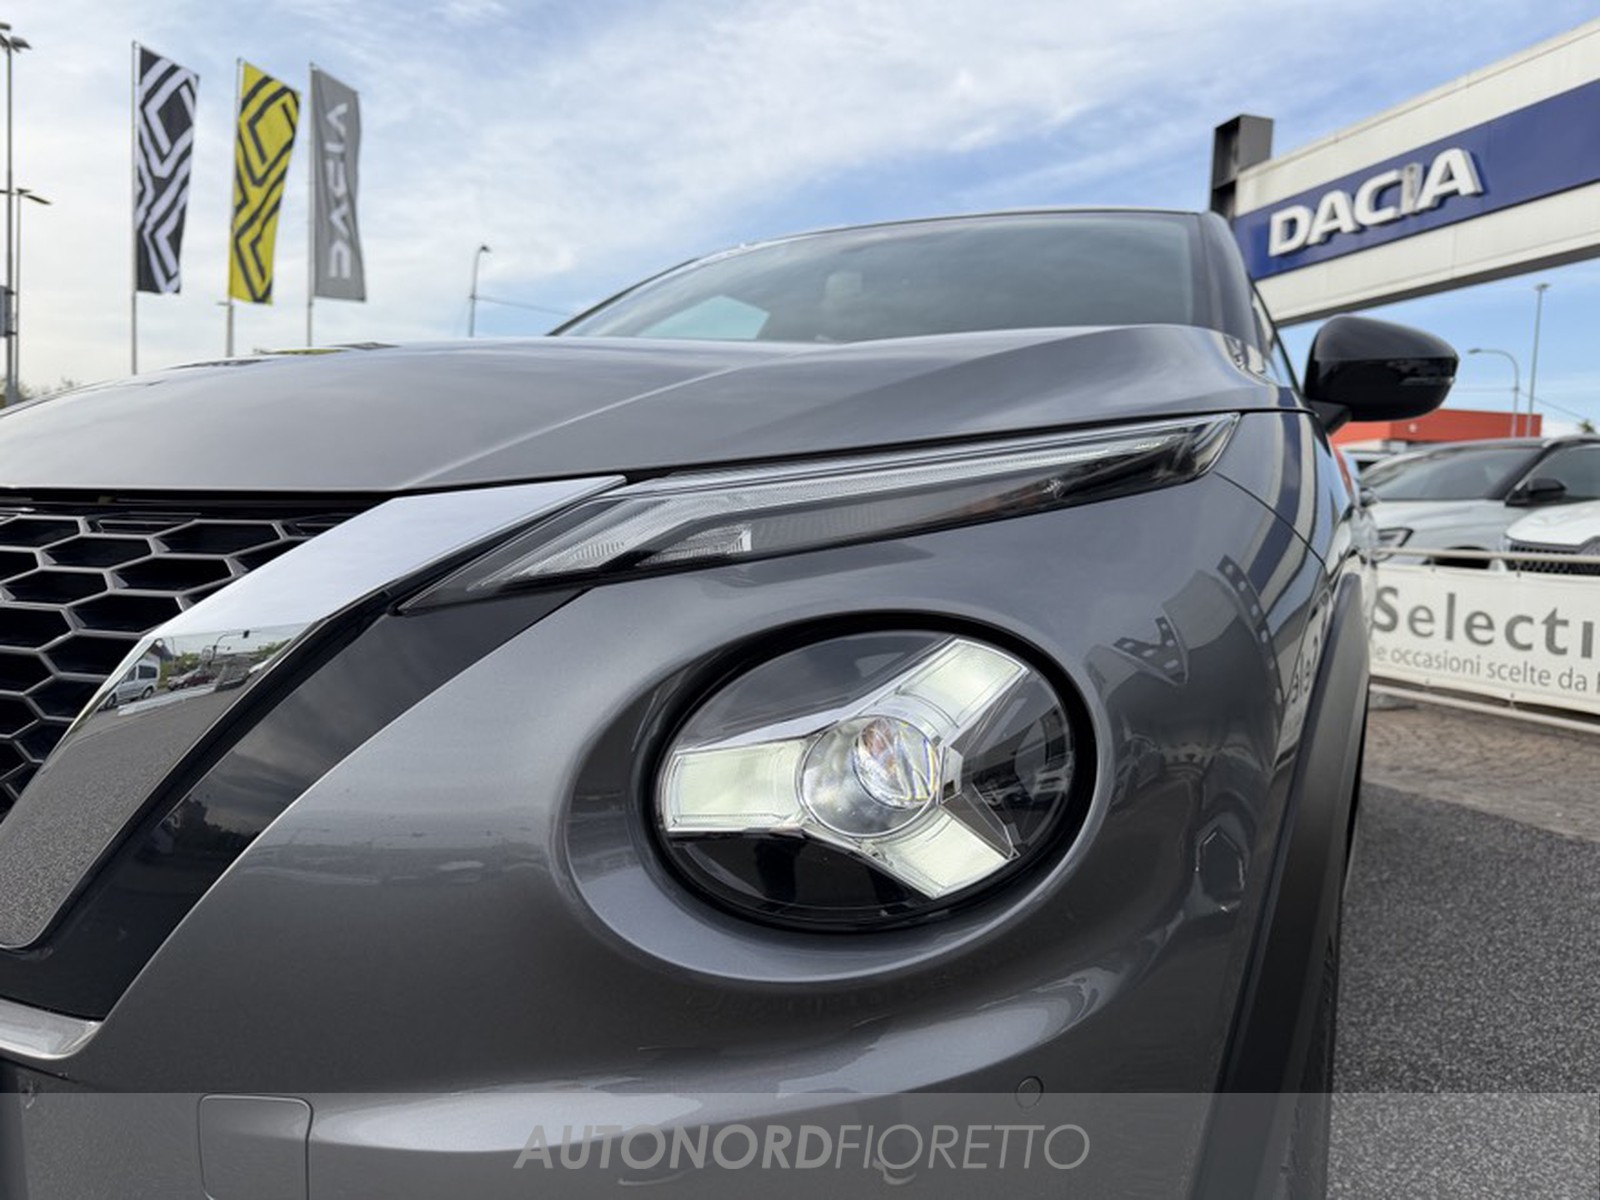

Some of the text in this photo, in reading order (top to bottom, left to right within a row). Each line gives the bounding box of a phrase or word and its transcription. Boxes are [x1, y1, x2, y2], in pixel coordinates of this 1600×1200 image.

[1268, 148, 1484, 258] DACIA
[1390, 646, 1482, 676] occasioni
[1485, 660, 1551, 687] scelte
[1557, 666, 1588, 692] da
